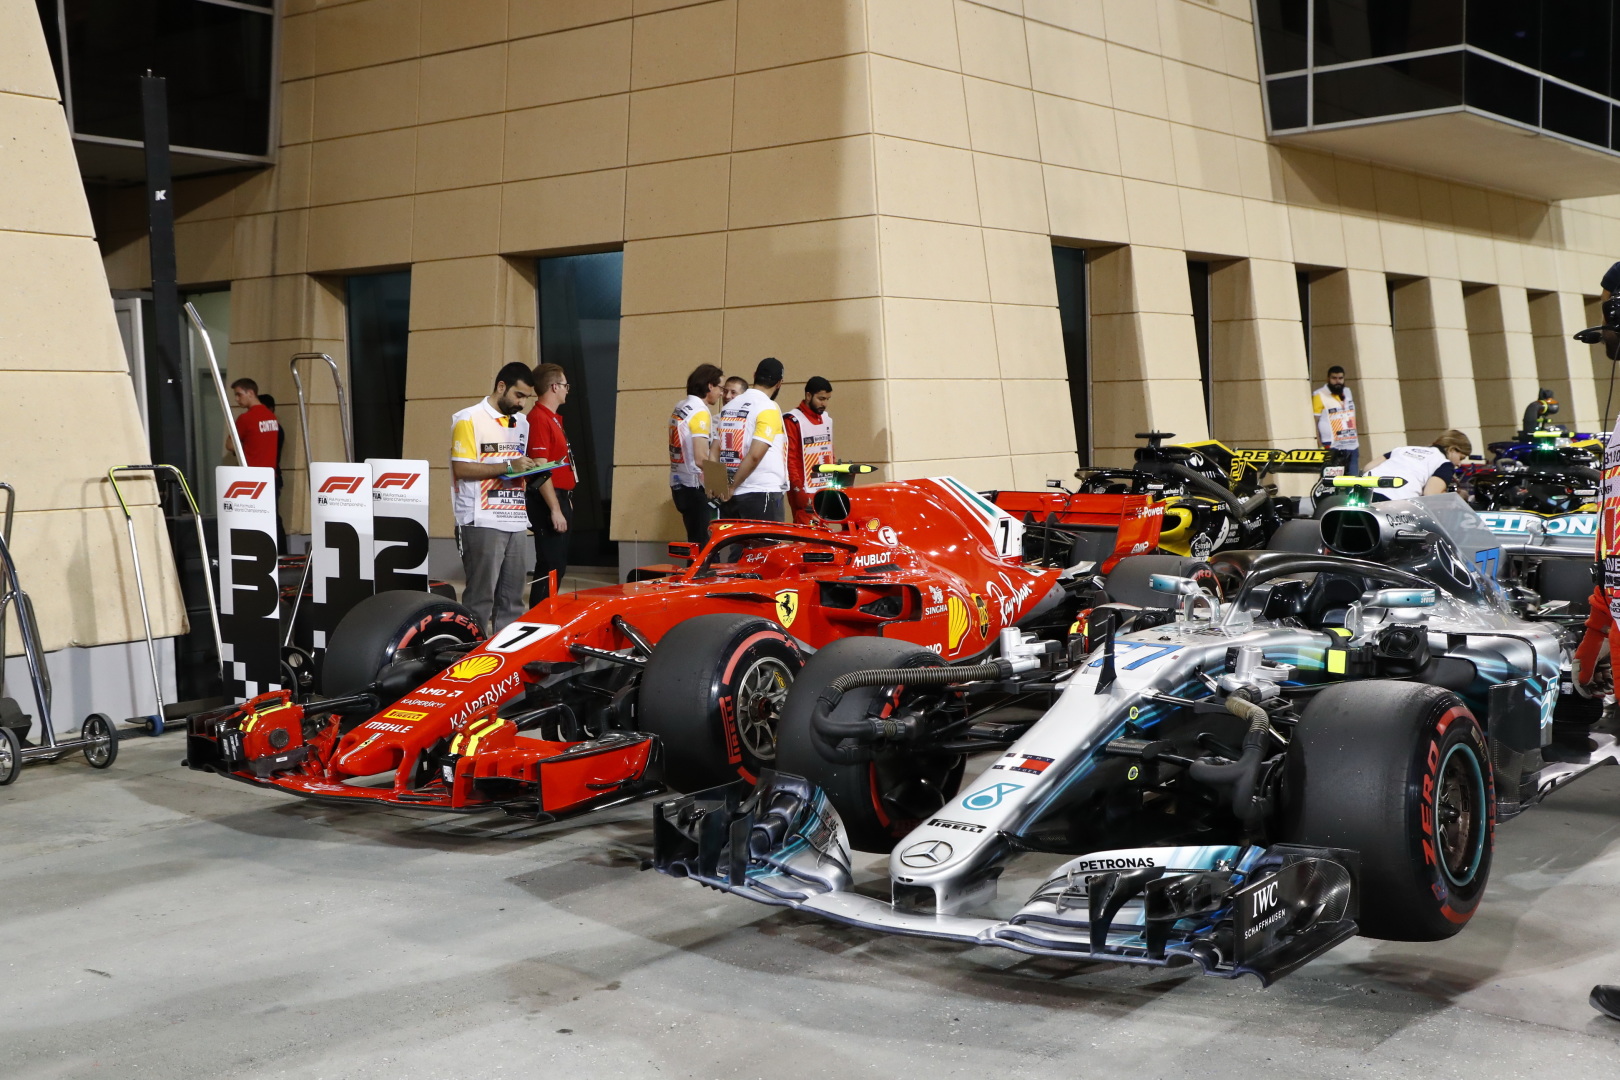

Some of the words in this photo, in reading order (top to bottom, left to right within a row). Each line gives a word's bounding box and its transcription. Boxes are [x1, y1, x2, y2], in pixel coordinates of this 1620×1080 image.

[1230, 458, 1246, 481] 27
[498, 490, 510, 498] PIT
[883, 529, 894, 544] E
[1000, 518, 1012, 555] 7
[325, 521, 374, 603] 1
[374, 516, 430, 593] 2
[856, 552, 892, 568] HUBLOT
[230, 528, 279, 619] 3
[420, 614, 433, 632] P
[497, 626, 542, 648] 7
[416, 687, 448, 696] AMD
[450, 676, 512, 729] KASPERSKY
[389, 710, 423, 720] PIRELLI
[366, 721, 414, 734] MAHLE
[718, 695, 742, 764] PIRELLI
[1420, 739, 1440, 866] ZERO
[927, 818, 988, 834] PIRELLI
[1080, 858, 1155, 870] PETRONAS
[1252, 880, 1278, 918] IWC
[1244, 908, 1286, 940] SCHAFFHAUSEN
